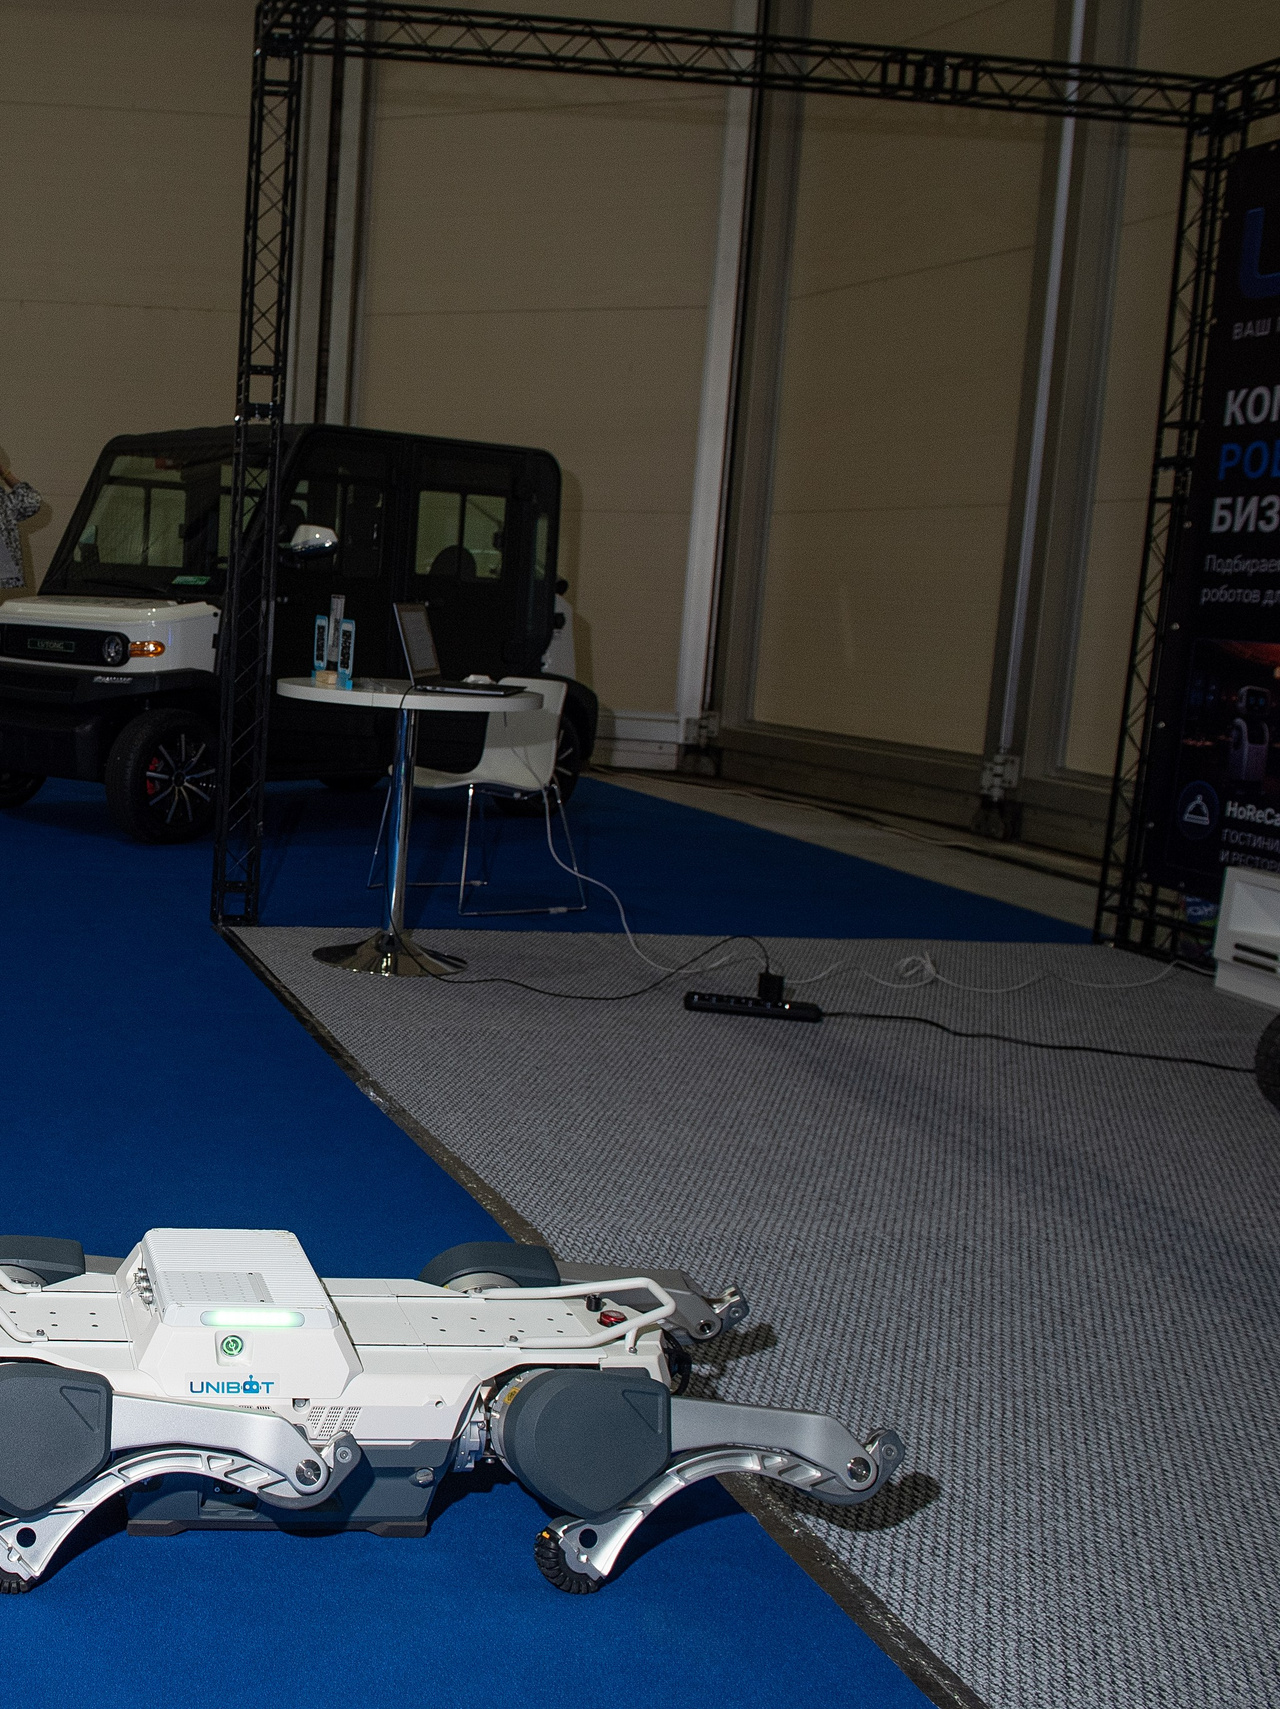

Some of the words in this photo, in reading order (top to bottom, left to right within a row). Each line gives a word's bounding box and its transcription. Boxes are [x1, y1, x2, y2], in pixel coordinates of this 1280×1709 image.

[1232, 317, 1272, 340] ВАШ
[1210, 494, 1280, 533] БИЗ
[1199, 583, 1261, 605] роботов
[1225, 800, 1280, 827] HoReCa
[1219, 849, 1230, 863] И
[1230, 852, 1280, 871] РЕСТОР
